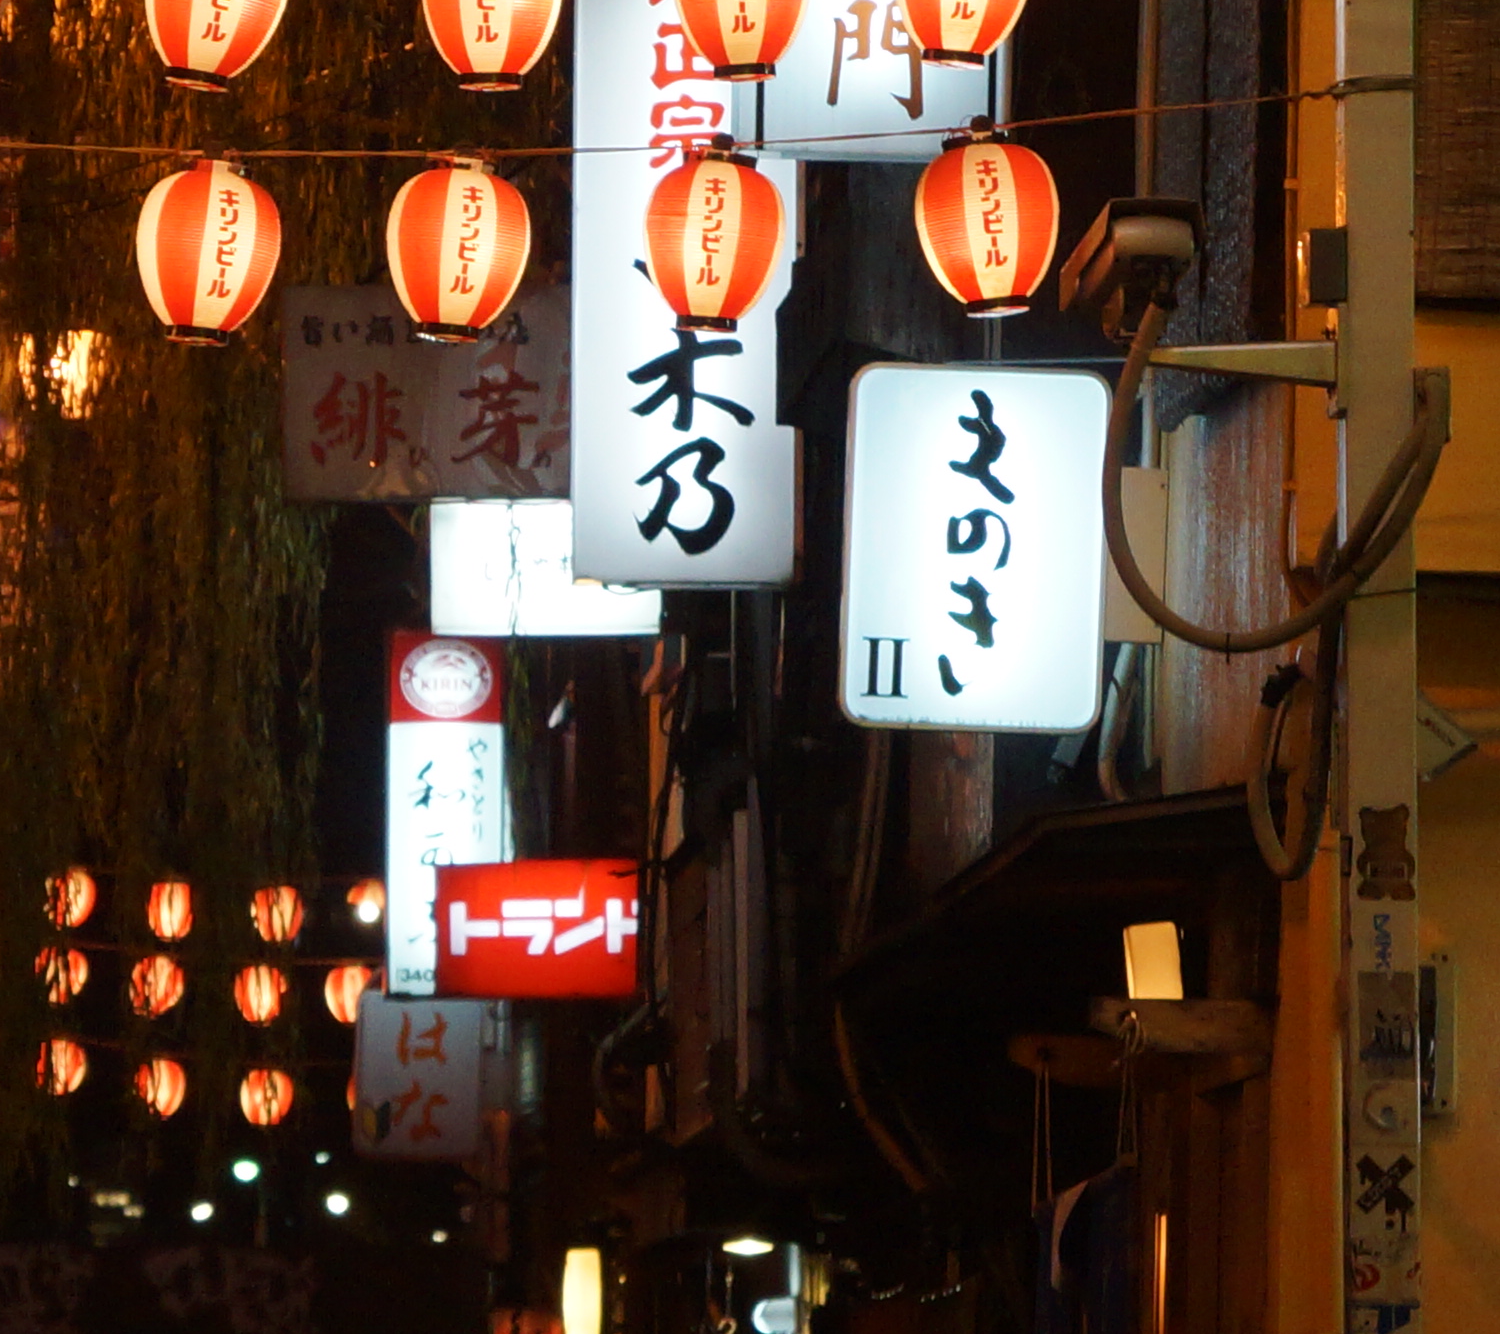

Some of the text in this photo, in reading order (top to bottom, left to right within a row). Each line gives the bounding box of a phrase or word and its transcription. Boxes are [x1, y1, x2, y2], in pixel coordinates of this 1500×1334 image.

[206, 190, 239, 299] キリンビール
[451, 186, 483, 295] キリンビール
[697, 178, 727, 286] キリンビール
[975, 158, 1008, 267] キリンビール
[627, 258, 755, 555] 木乃
[940, 389, 1015, 697] えのき
[421, 678, 474, 692] KIRIN
[391, 1011, 450, 1142] はな
